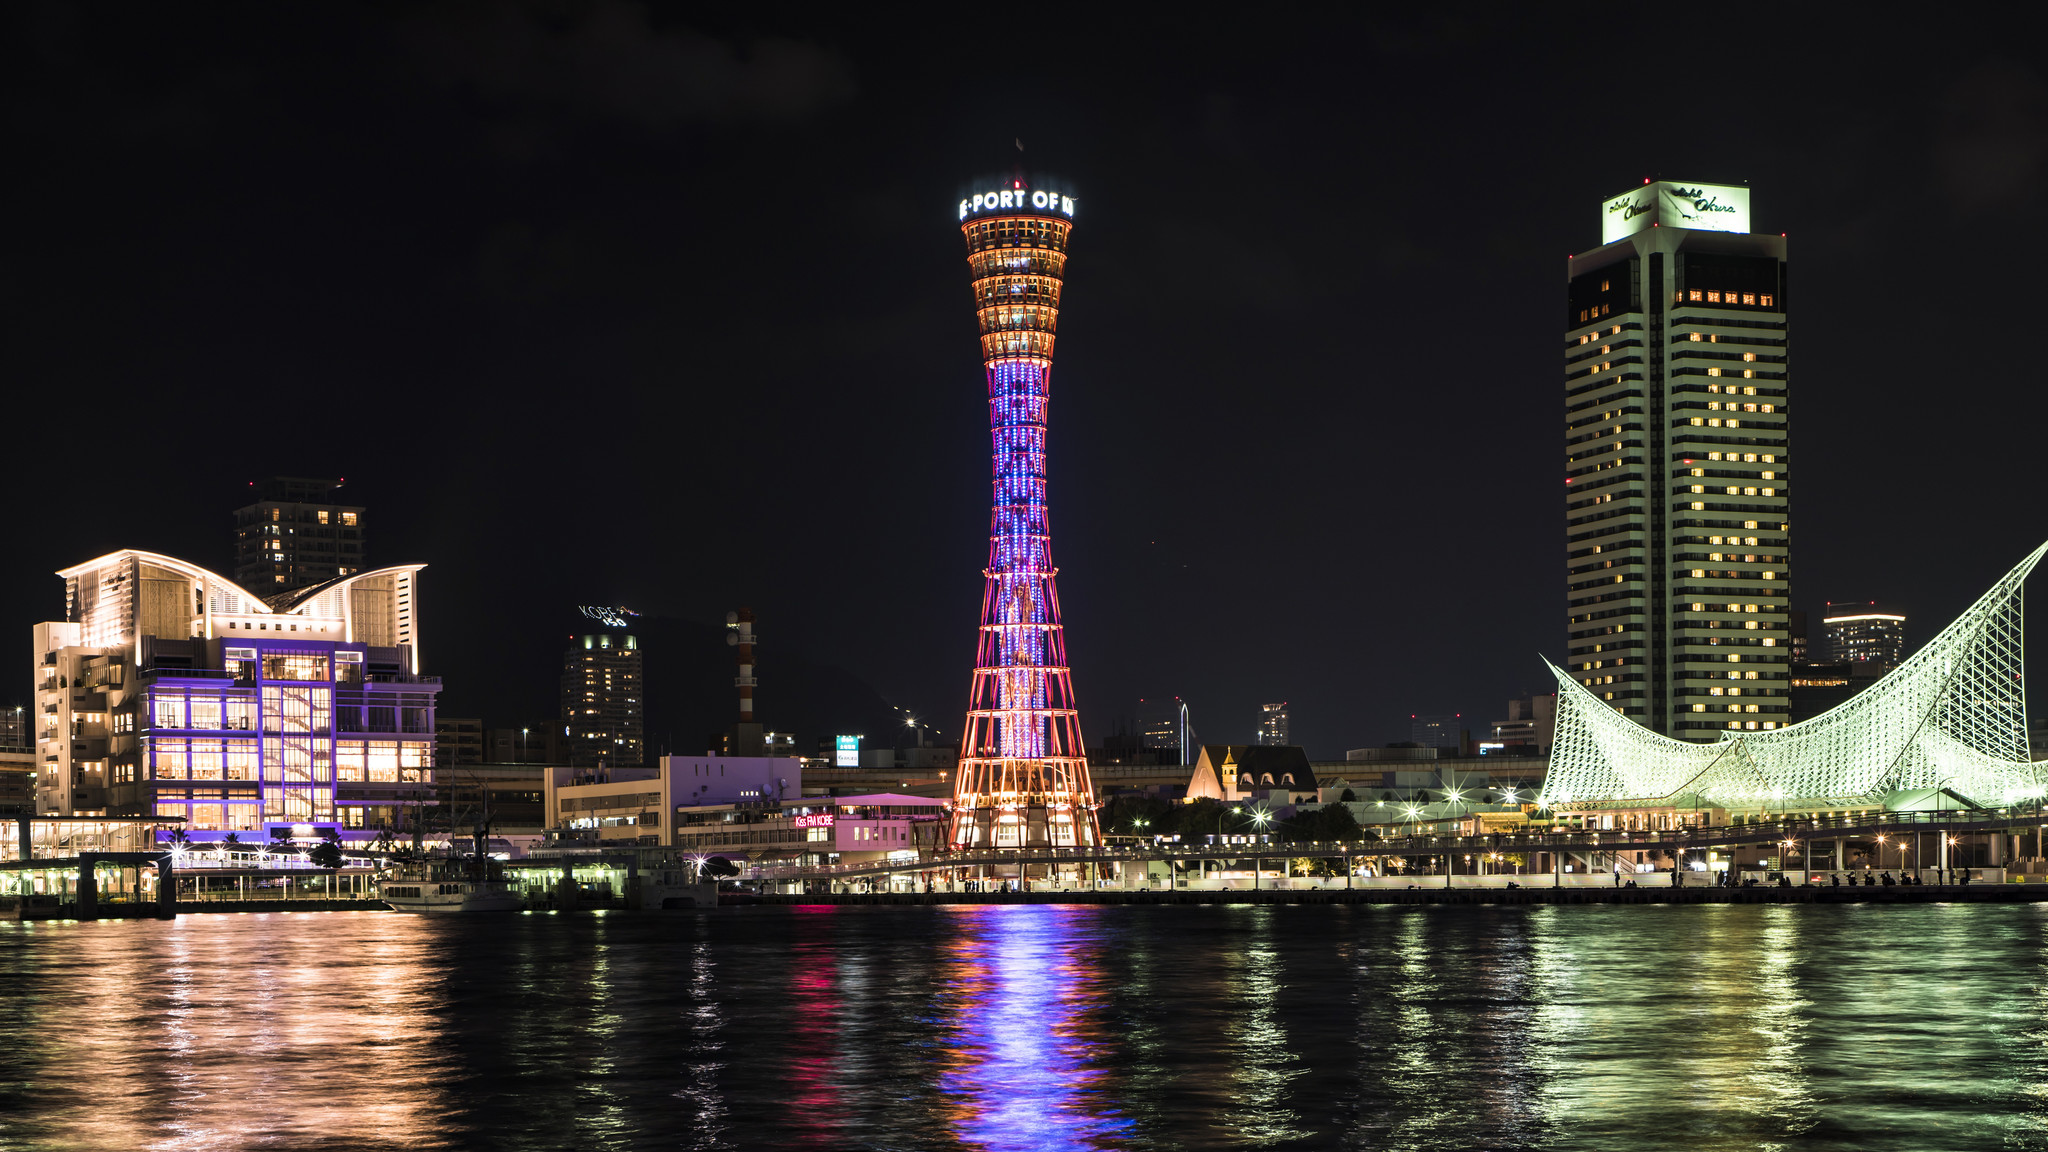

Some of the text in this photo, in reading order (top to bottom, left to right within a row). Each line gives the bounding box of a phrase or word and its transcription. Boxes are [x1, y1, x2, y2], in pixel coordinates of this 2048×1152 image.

[1032, 190, 1059, 210] OF
[1694, 196, 1736, 212] Okura
[578, 605, 618, 620] KOBE
[795, 814, 834, 827] Kiss FM KOBE
